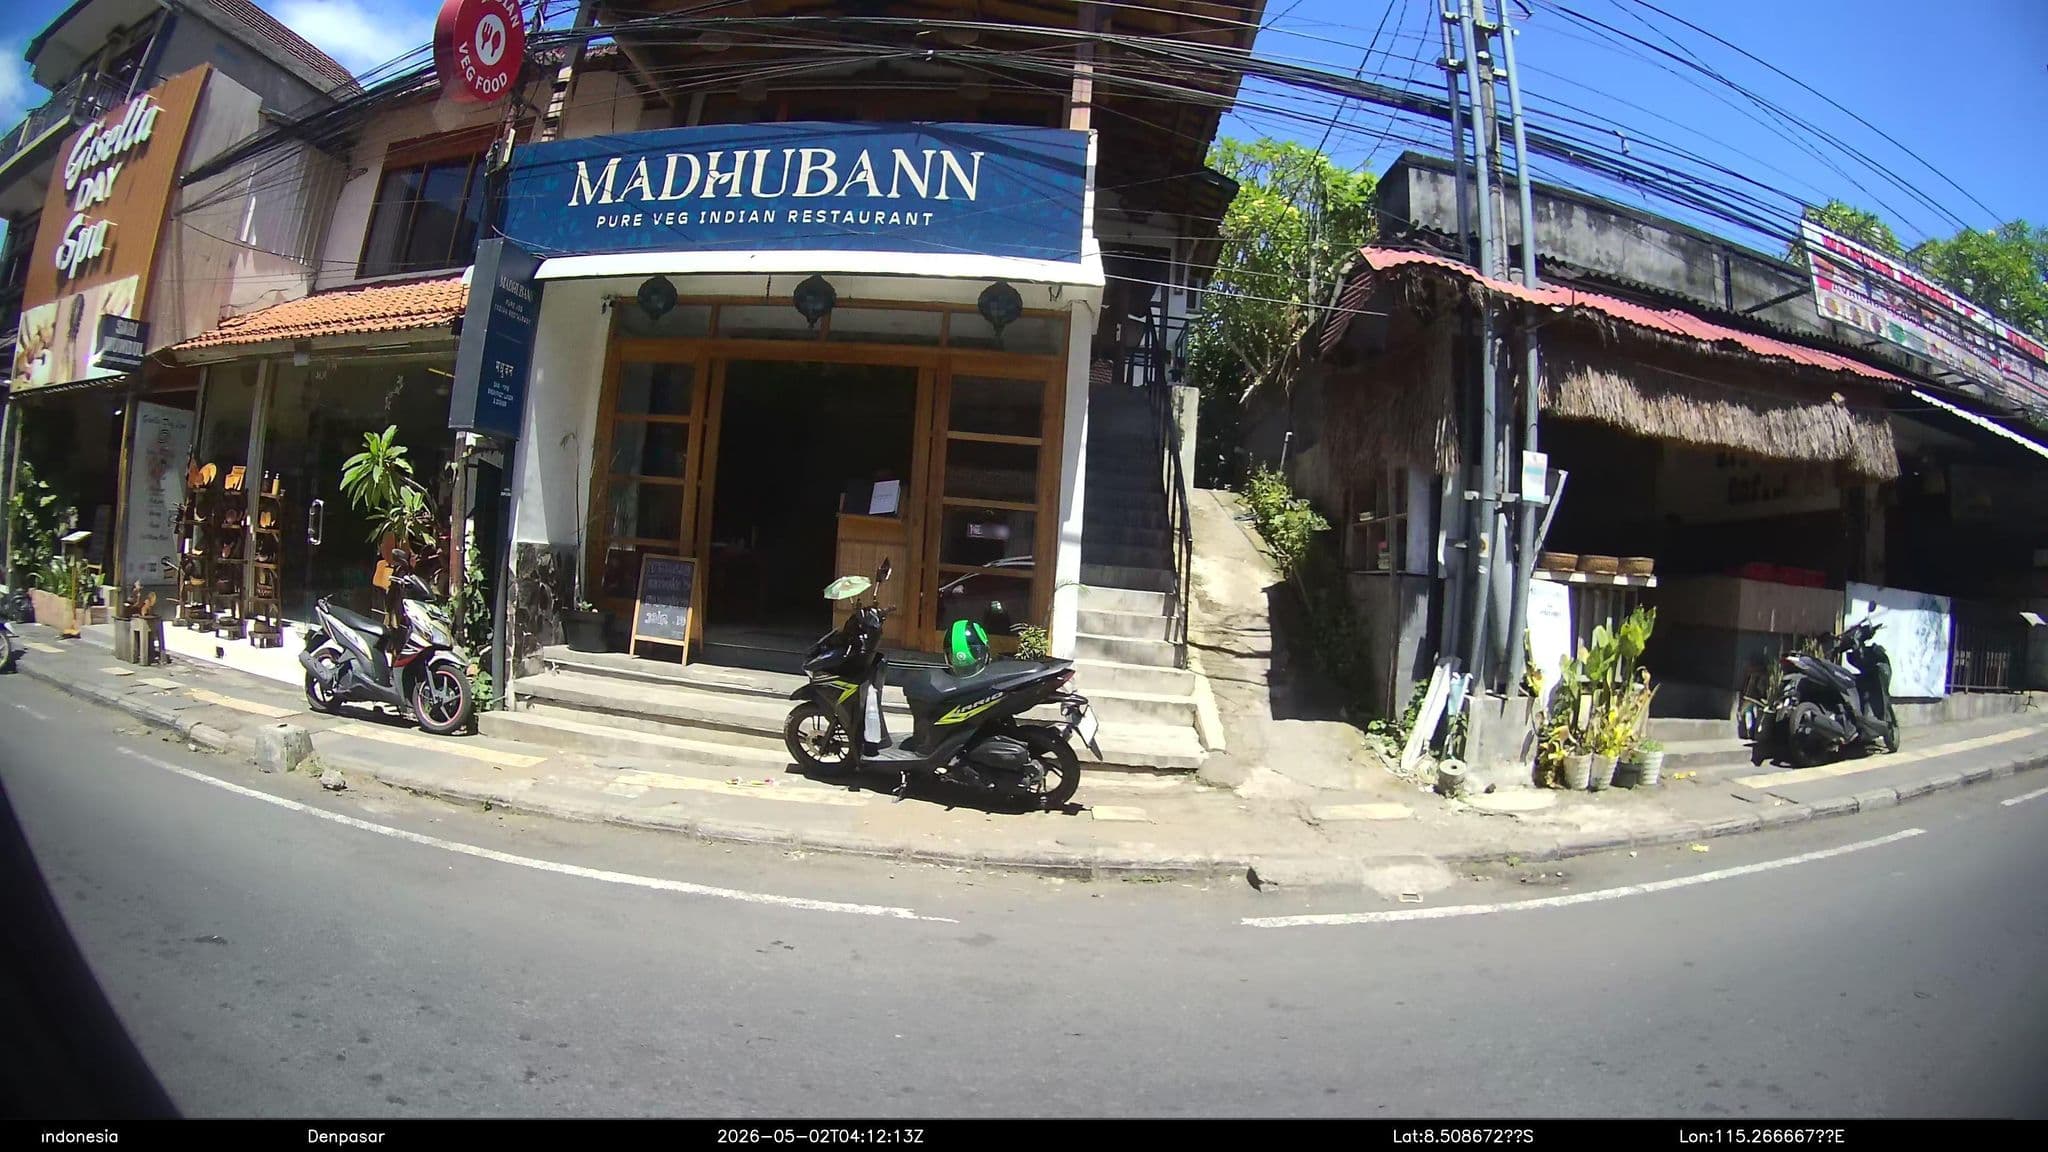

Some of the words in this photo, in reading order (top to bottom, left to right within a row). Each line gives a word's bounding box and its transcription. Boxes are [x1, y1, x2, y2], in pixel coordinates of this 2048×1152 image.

[459, 41, 476, 82] VEG
[475, 72, 508, 93] FOOD
[74, 162, 123, 212] DAY
[568, 148, 985, 207] MADHUBANN
[596, 213, 643, 229] PURE
[653, 212, 689, 226] VEG
[699, 210, 776, 225] INDIAN
[788, 208, 936, 227] RESTAURANT
[56, 213, 114, 279] Spa
